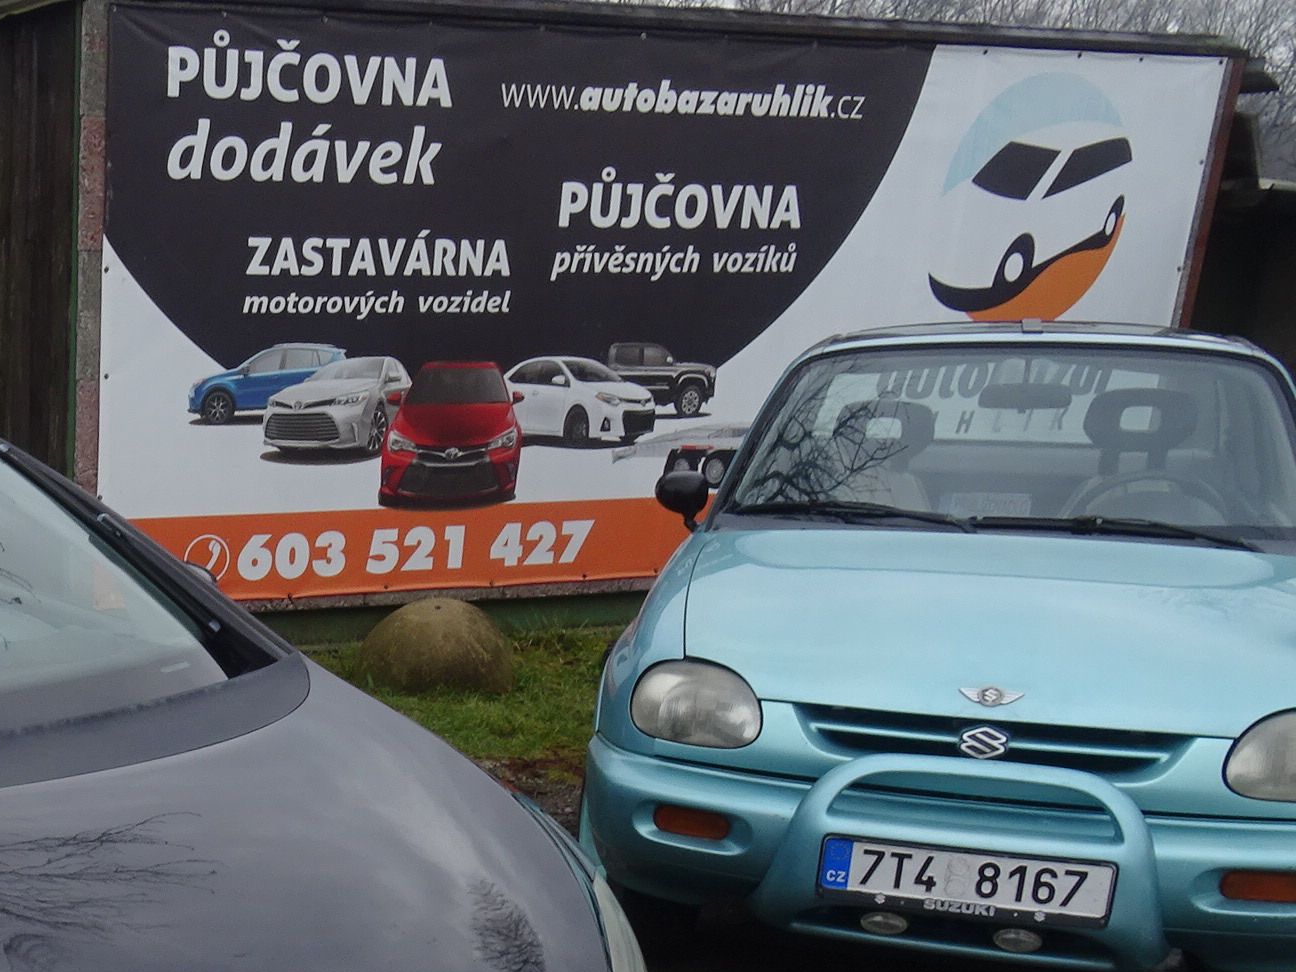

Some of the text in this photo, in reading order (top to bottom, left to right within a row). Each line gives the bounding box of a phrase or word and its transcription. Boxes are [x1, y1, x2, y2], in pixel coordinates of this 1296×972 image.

[166, 29, 453, 108] PŮJČOVNA
[501, 79, 866, 120] www.autobazaruhlik.cz
[166, 118, 443, 185] dodávek
[557, 166, 802, 230] PŮJČOVNA
[245, 229, 512, 277] ZASTAVÁRNA
[549, 243, 798, 282] přívěsných vozíků
[242, 290, 512, 320] motorových vozidel
[236, 519, 596, 582] 603 521 427
[825, 869, 846, 883] CZ
[858, 848, 1089, 908] 7T4 8167
[922, 897, 997, 918] SUZUKI
